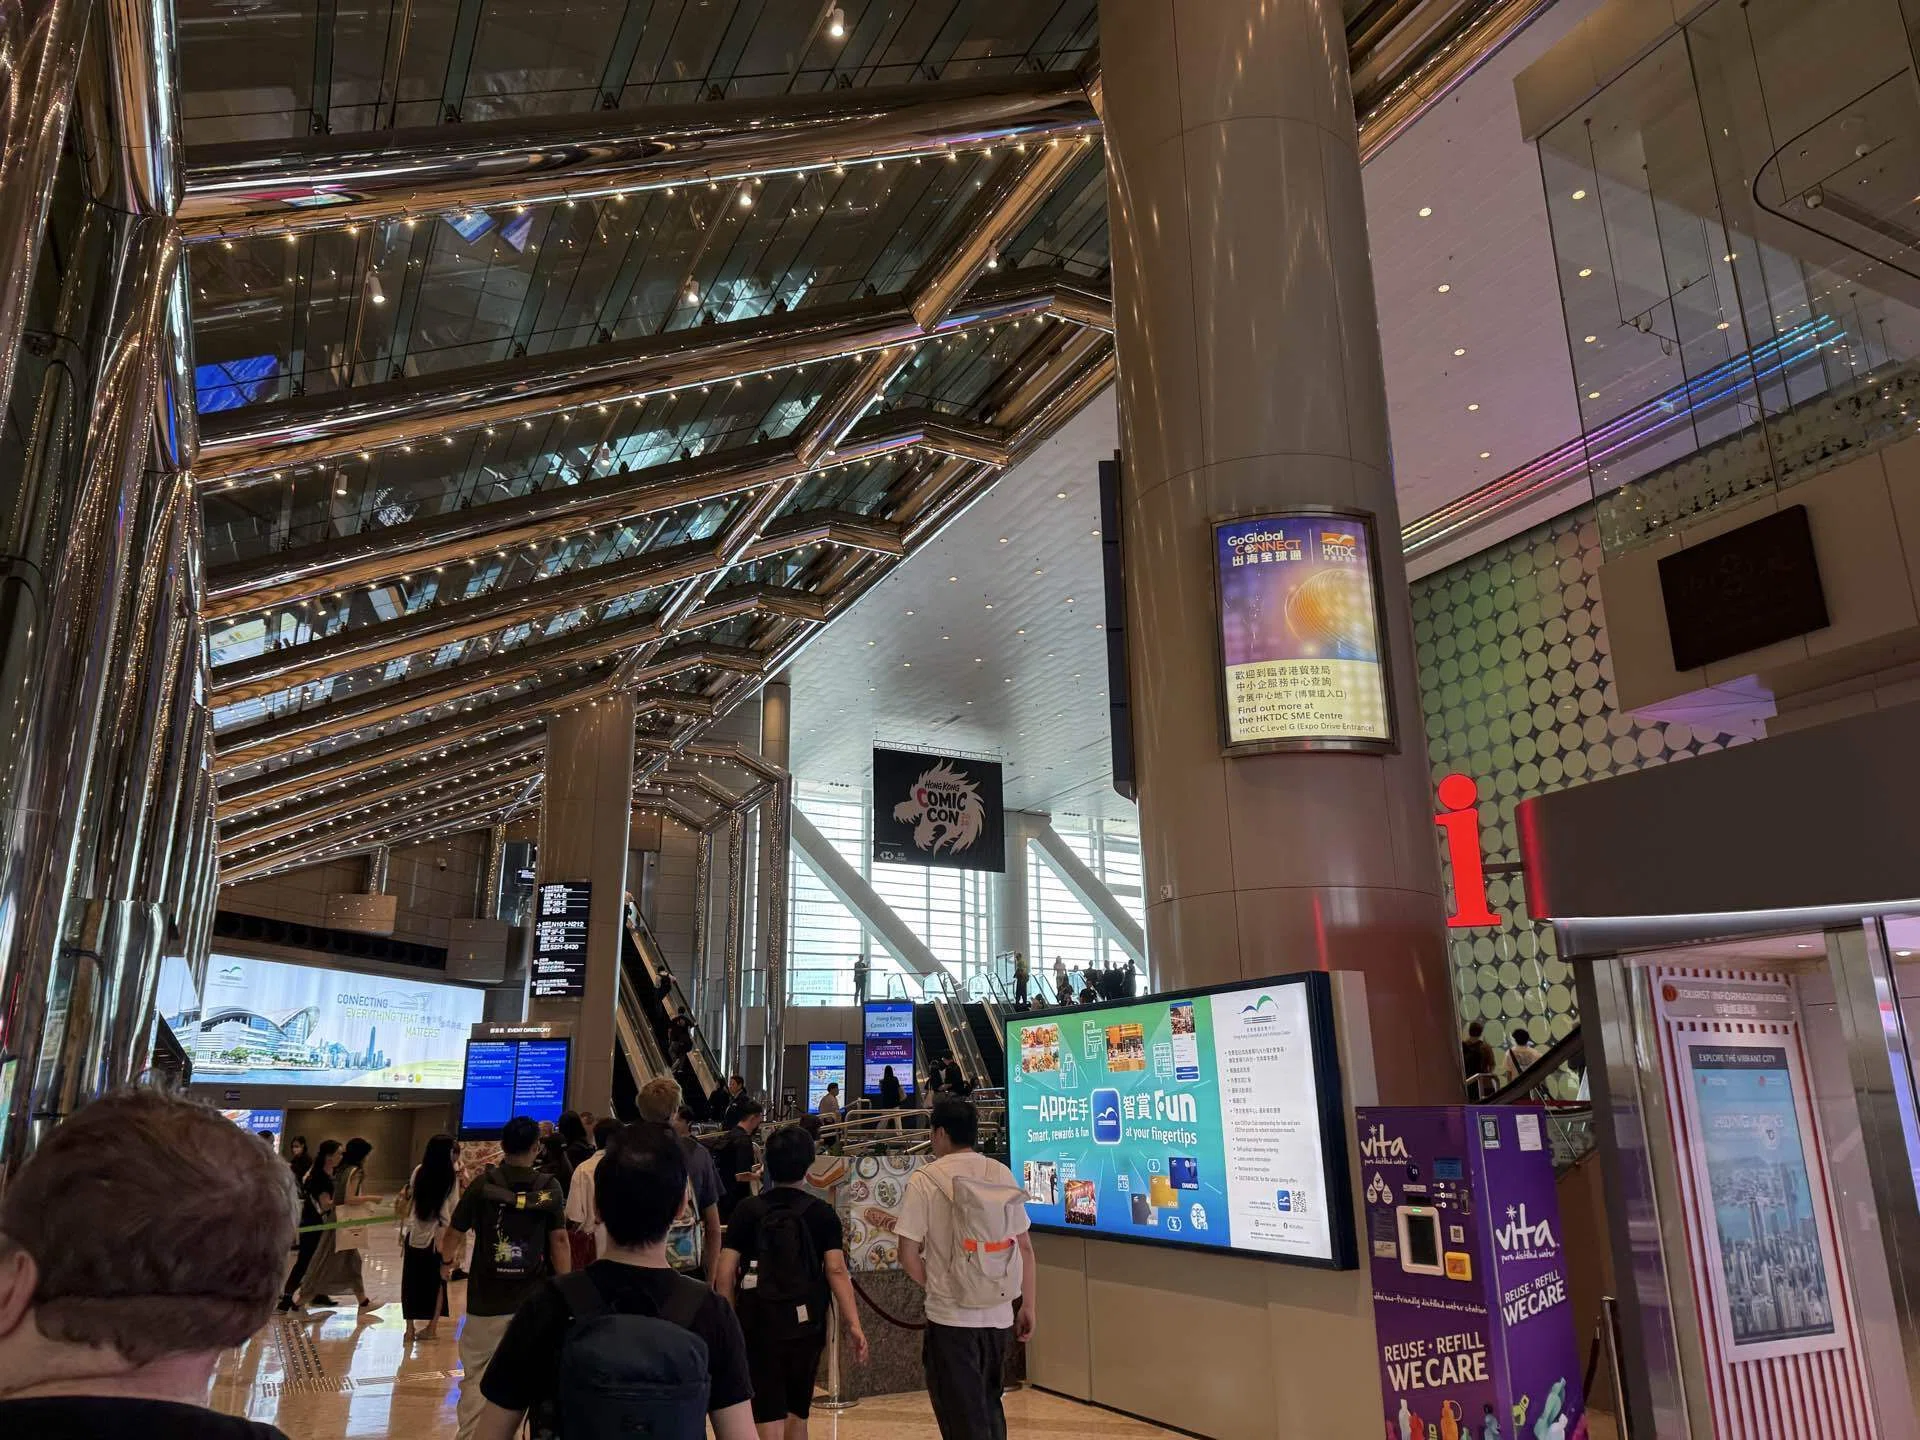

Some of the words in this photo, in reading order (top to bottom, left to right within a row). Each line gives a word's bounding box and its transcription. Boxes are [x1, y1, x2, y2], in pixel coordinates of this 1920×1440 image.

[1227, 530, 1283, 546] GoGlobal
[1235, 540, 1301, 555] CONNECT
[1322, 544, 1356, 557] HKTDC
[1238, 706, 1257, 714] Find
[1239, 716, 1254, 725] the
[1256, 713, 1288, 722] HKTDC
[1291, 712, 1311, 720] SME
[1313, 711, 1343, 720] Centre
[1240, 725, 1265, 734] HKCEC
[1267, 723, 1287, 732] Level
[1297, 722, 1318, 731] (Expo
[1342, 723, 1375, 732] Entrance)
[924, 781, 942, 790] HONG
[942, 782, 960, 792] KONG
[916, 787, 967, 811] COMIC
[926, 808, 959, 826] CON
[337, 993, 388, 1008] CONNECTING
[346, 1007, 397, 1024] EVERYTHING
[398, 1011, 418, 1024] THAT
[406, 1027, 440, 1038] MATTERS
[1028, 1129, 1051, 1143] Smart,
[1051, 1128, 1075, 1141] rewards
[1080, 1127, 1089, 1137] fun
[1125, 1127, 1133, 1137] at
[1133, 1128, 1150, 1140] your
[1151, 1126, 1198, 1148] fingertips
[1360, 1124, 1408, 1158] vita
[1496, 1203, 1556, 1251] vita
[1538, 1248, 1555, 1258] water
[1504, 1283, 1530, 1303] REUSE
[1534, 1269, 1561, 1289] REFILL
[1445, 1302, 1464, 1312] water
[1384, 1340, 1427, 1362] REUSE
[1435, 1331, 1485, 1354] REFILL
